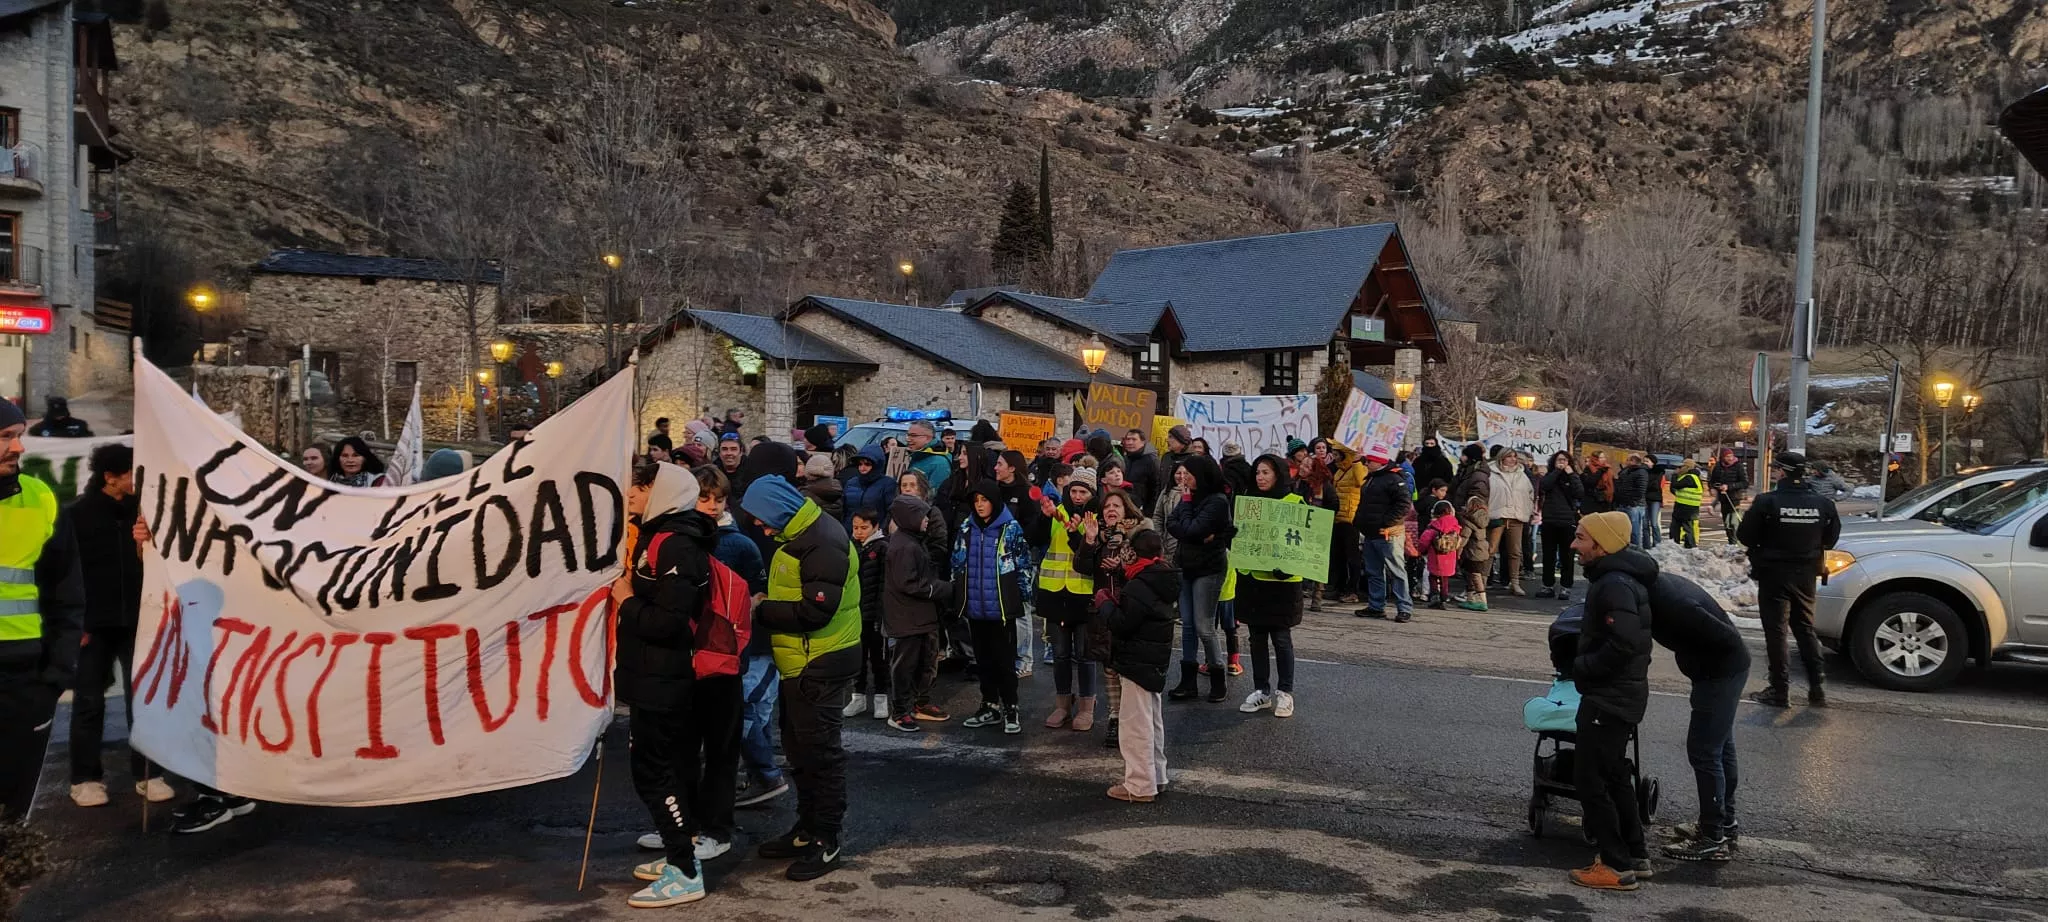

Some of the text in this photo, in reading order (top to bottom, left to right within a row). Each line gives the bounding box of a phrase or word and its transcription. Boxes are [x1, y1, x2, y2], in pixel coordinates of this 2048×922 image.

[1090, 384, 1151, 408] VALLE
[1088, 407, 1142, 429] UNIDO
[1182, 398, 1262, 424] VALLE
[1512, 415, 1526, 427] HA
[1184, 414, 1314, 460] EPARADO
[1548, 428, 1562, 439] EN
[196, 440, 341, 532] UN
[371, 439, 535, 542] VLLE
[1268, 500, 1315, 529] VALLE
[1780, 507, 1820, 517] POLICIA
[201, 586, 613, 759] INSTITUTO
